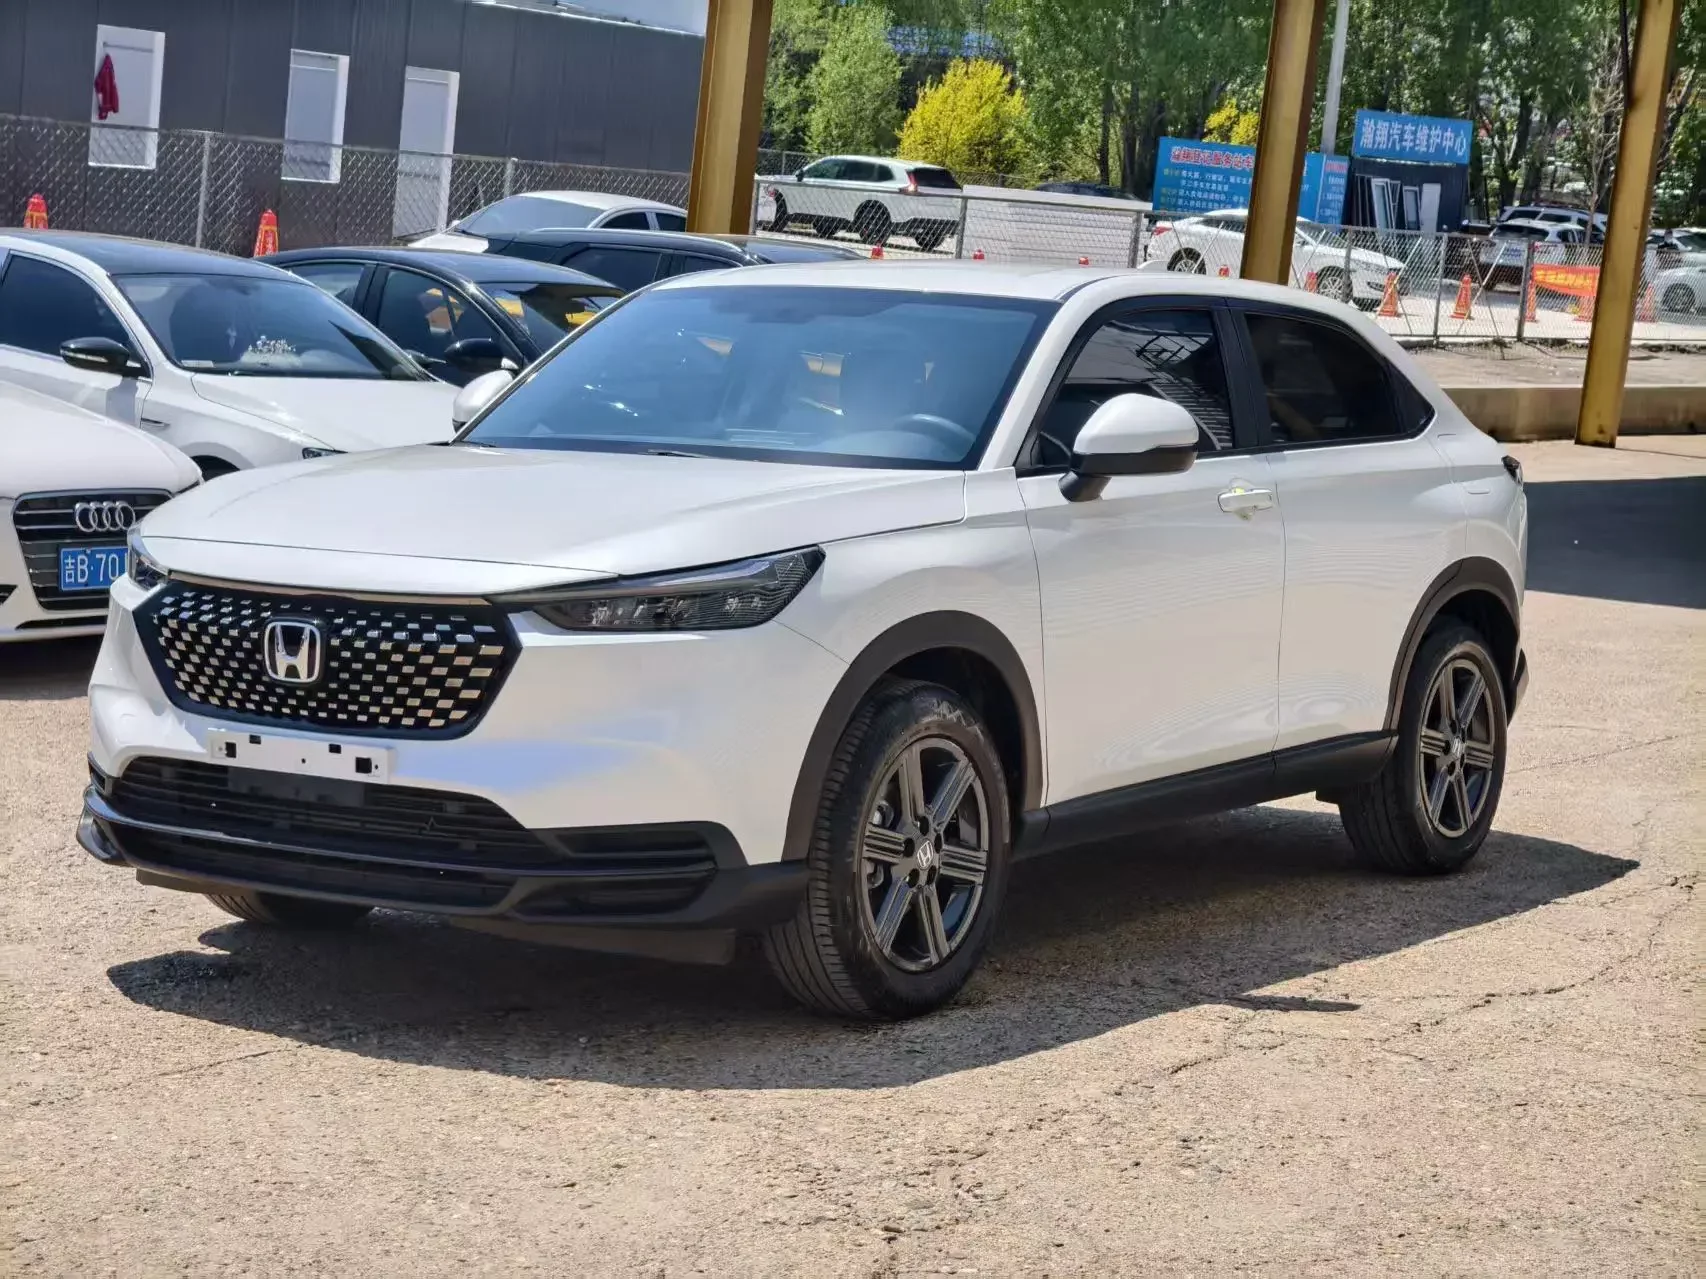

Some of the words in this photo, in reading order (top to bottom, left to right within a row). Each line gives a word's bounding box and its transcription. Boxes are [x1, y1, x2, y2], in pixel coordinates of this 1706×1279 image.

[1360, 118, 1466, 156] 瀚翔汽车维护中心
[63, 553, 128, 584] 吉B·70
